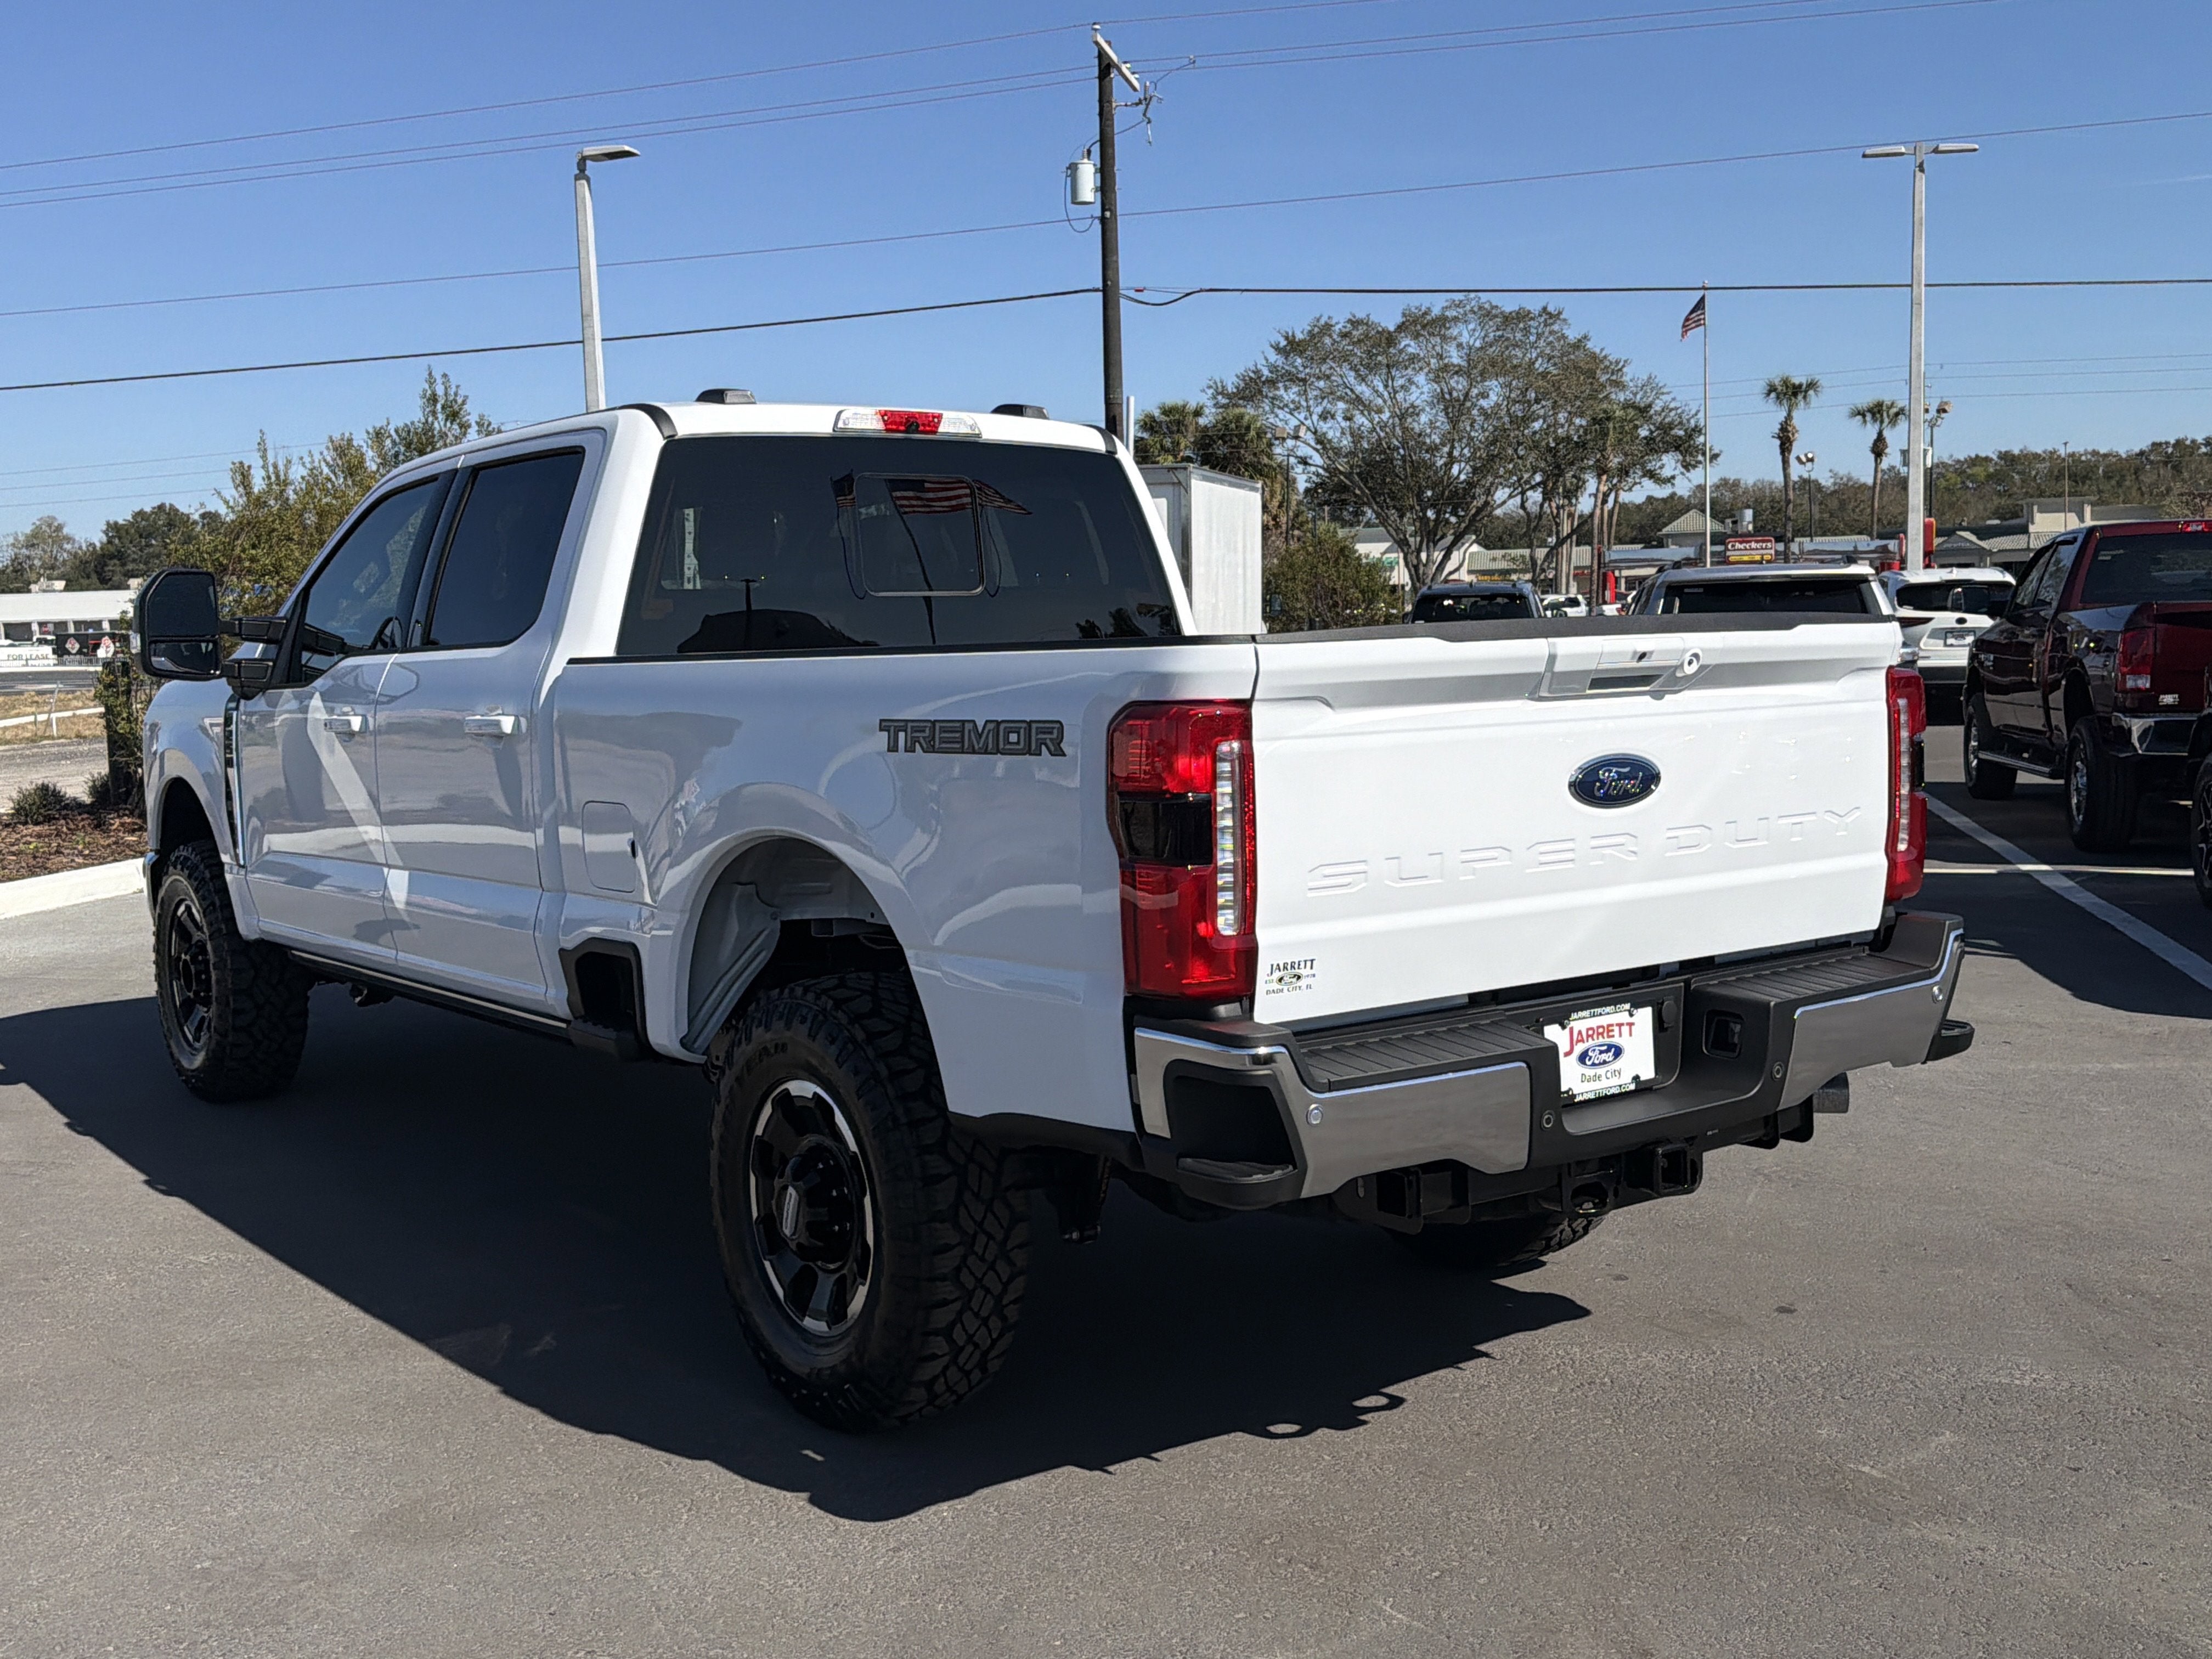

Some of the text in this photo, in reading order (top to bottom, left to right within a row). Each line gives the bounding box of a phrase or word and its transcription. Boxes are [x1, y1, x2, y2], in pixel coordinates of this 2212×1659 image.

[1728, 541, 1772, 550] Checkers
[879, 719, 1066, 757] TREMOR
[1594, 766, 1643, 797] Ford
[1307, 806, 1863, 898] SUPER DUTY
[1267, 958, 1316, 977] JARRETT
[1266, 987, 1284, 996] DADE
[1570, 1003, 1630, 1020] JARRETTFORD.COM
[1564, 1022, 1635, 1057] JARRETT
[1585, 1045, 1615, 1065] Ford
[1581, 1068, 1622, 1083] Dade City
[1574, 1082, 1636, 1102] JARRETTFORD.COM
